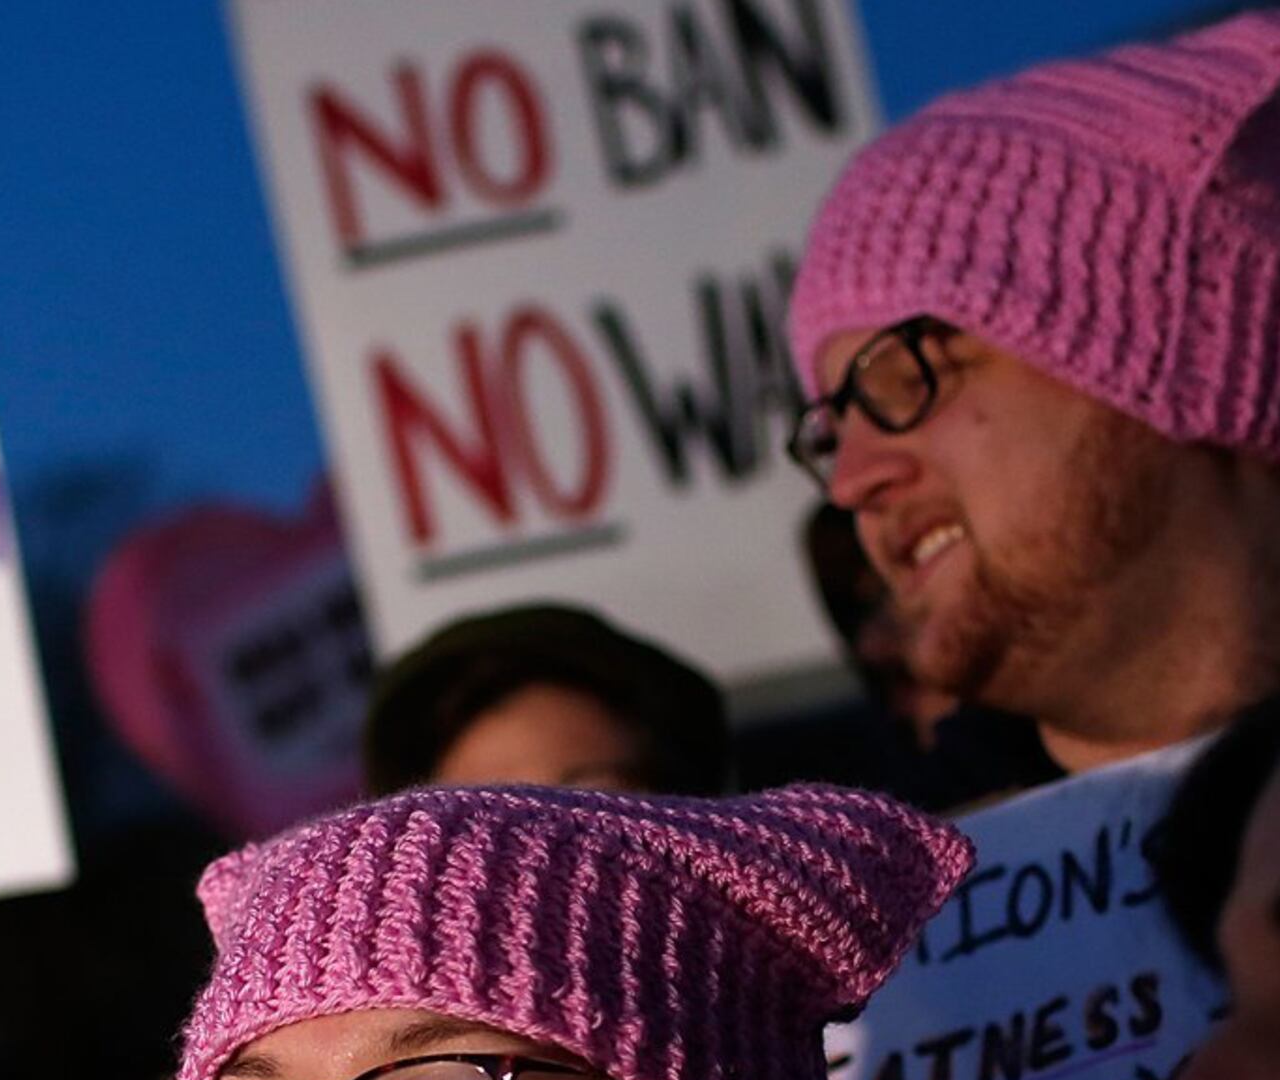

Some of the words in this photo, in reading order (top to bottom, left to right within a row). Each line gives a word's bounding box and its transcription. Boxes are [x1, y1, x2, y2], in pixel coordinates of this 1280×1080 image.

[308, 46, 554, 248] NO
[578, 0, 844, 190] BAN
[368, 304, 612, 546] NO
[914, 820, 1164, 966] ION'S
